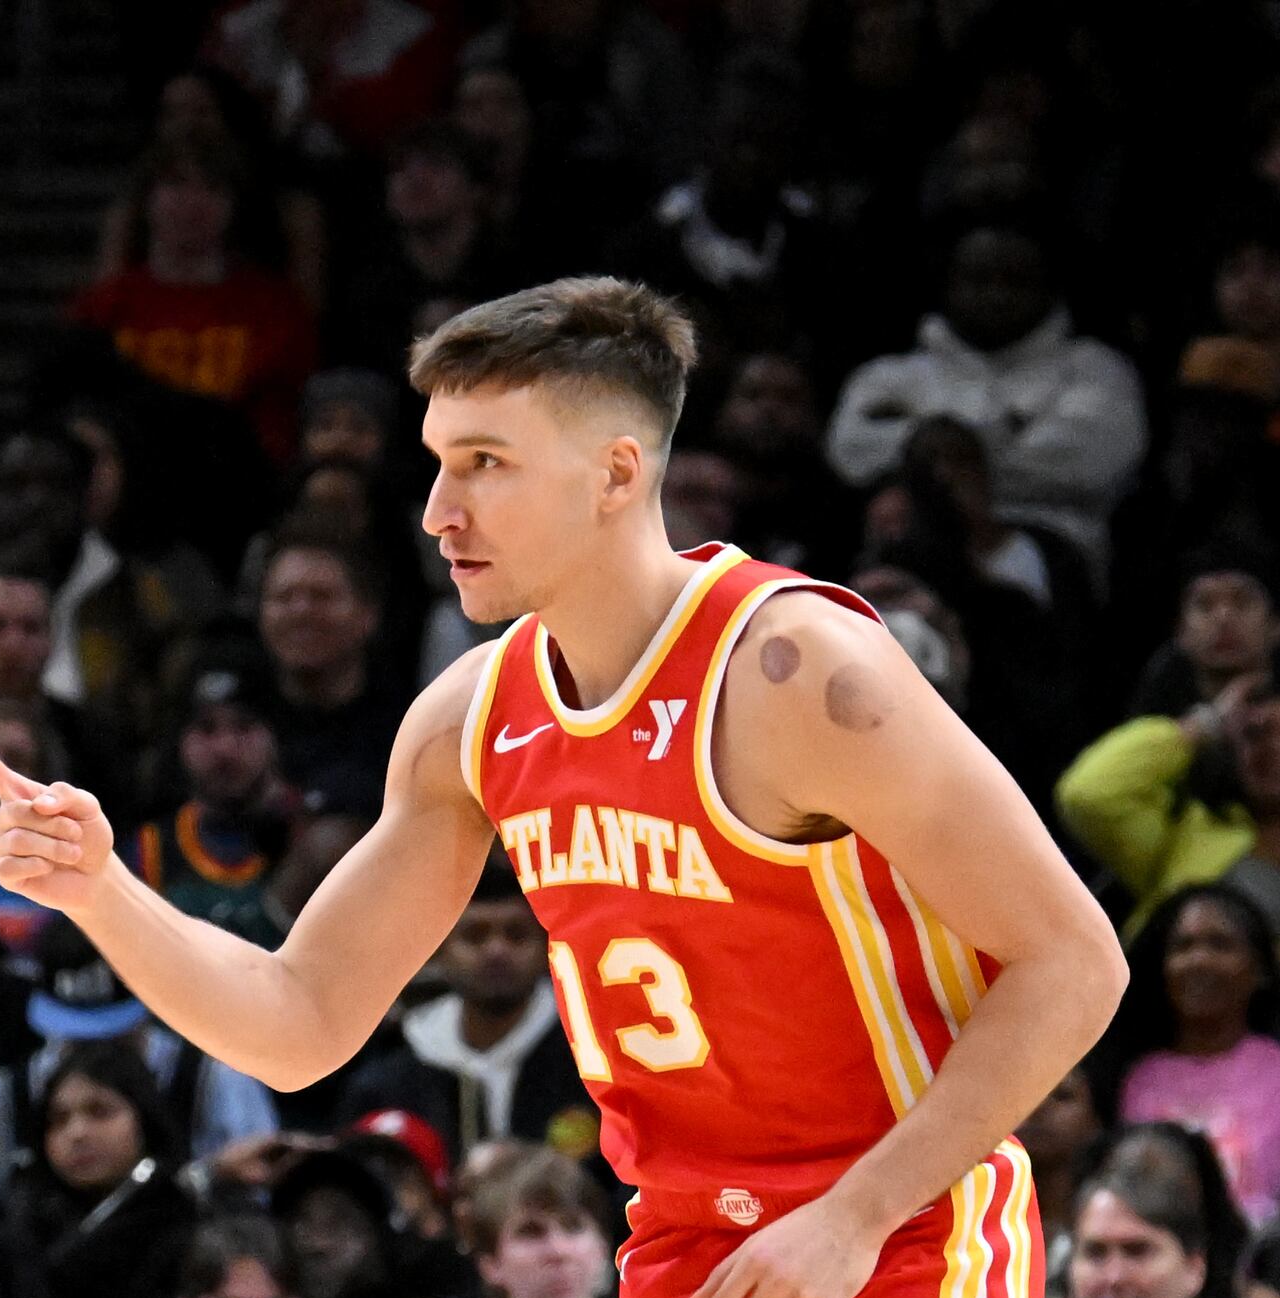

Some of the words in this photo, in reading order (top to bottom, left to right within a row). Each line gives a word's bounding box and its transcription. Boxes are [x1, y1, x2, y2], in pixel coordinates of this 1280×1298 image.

[632, 728, 652, 742] the
[499, 804, 735, 903] TLANTA
[549, 937, 712, 1083] 13
[714, 1198, 764, 1215] HAWKS
